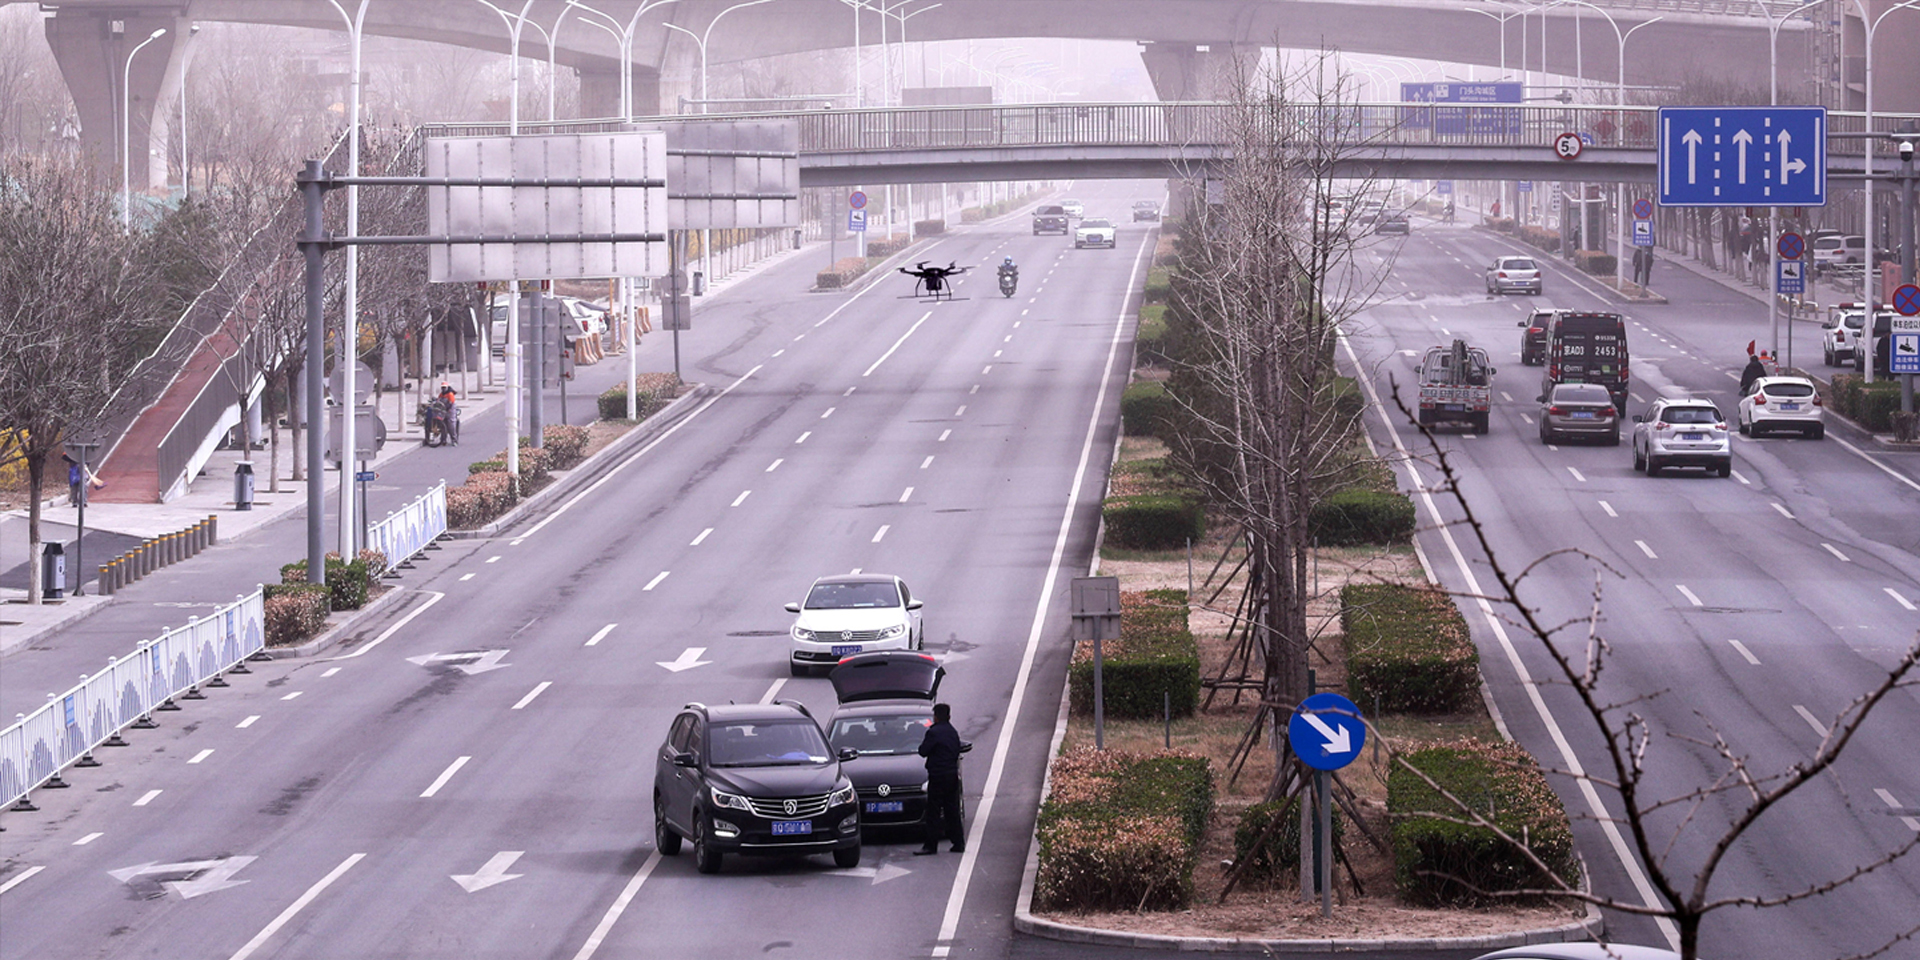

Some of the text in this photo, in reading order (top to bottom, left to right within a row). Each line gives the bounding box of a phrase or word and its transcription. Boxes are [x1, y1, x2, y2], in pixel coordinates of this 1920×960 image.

[1459, 86, 1497, 96] 门头沟城区
[1595, 346, 1616, 356] 2453
